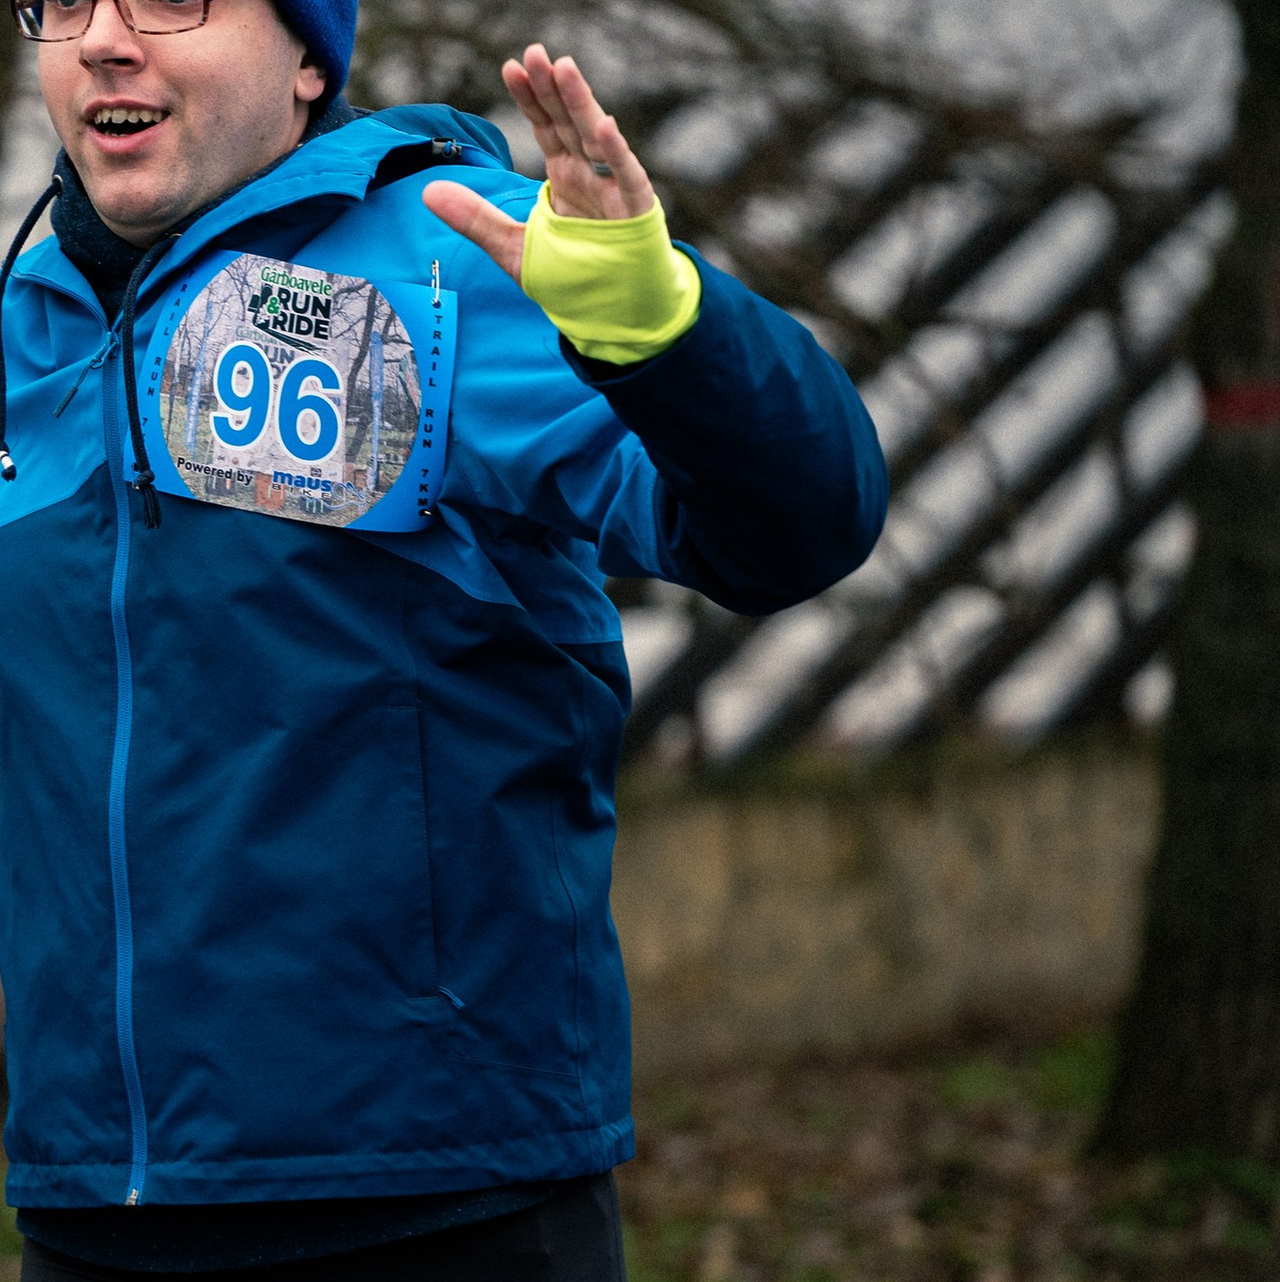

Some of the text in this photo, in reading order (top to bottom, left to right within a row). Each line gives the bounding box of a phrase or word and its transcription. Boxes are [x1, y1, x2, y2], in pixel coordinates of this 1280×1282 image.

[266, 296, 280, 314] &
[277, 287, 332, 319] RUN
[271, 311, 331, 340] RIDE
[428, 315, 444, 388] TRAIL
[147, 357, 162, 397] RUN
[211, 342, 341, 463] 96
[423, 409, 435, 448] RUN
[176, 457, 253, 486] Powered by
[273, 470, 332, 492] maus
[271, 483, 333, 500] BIKE
